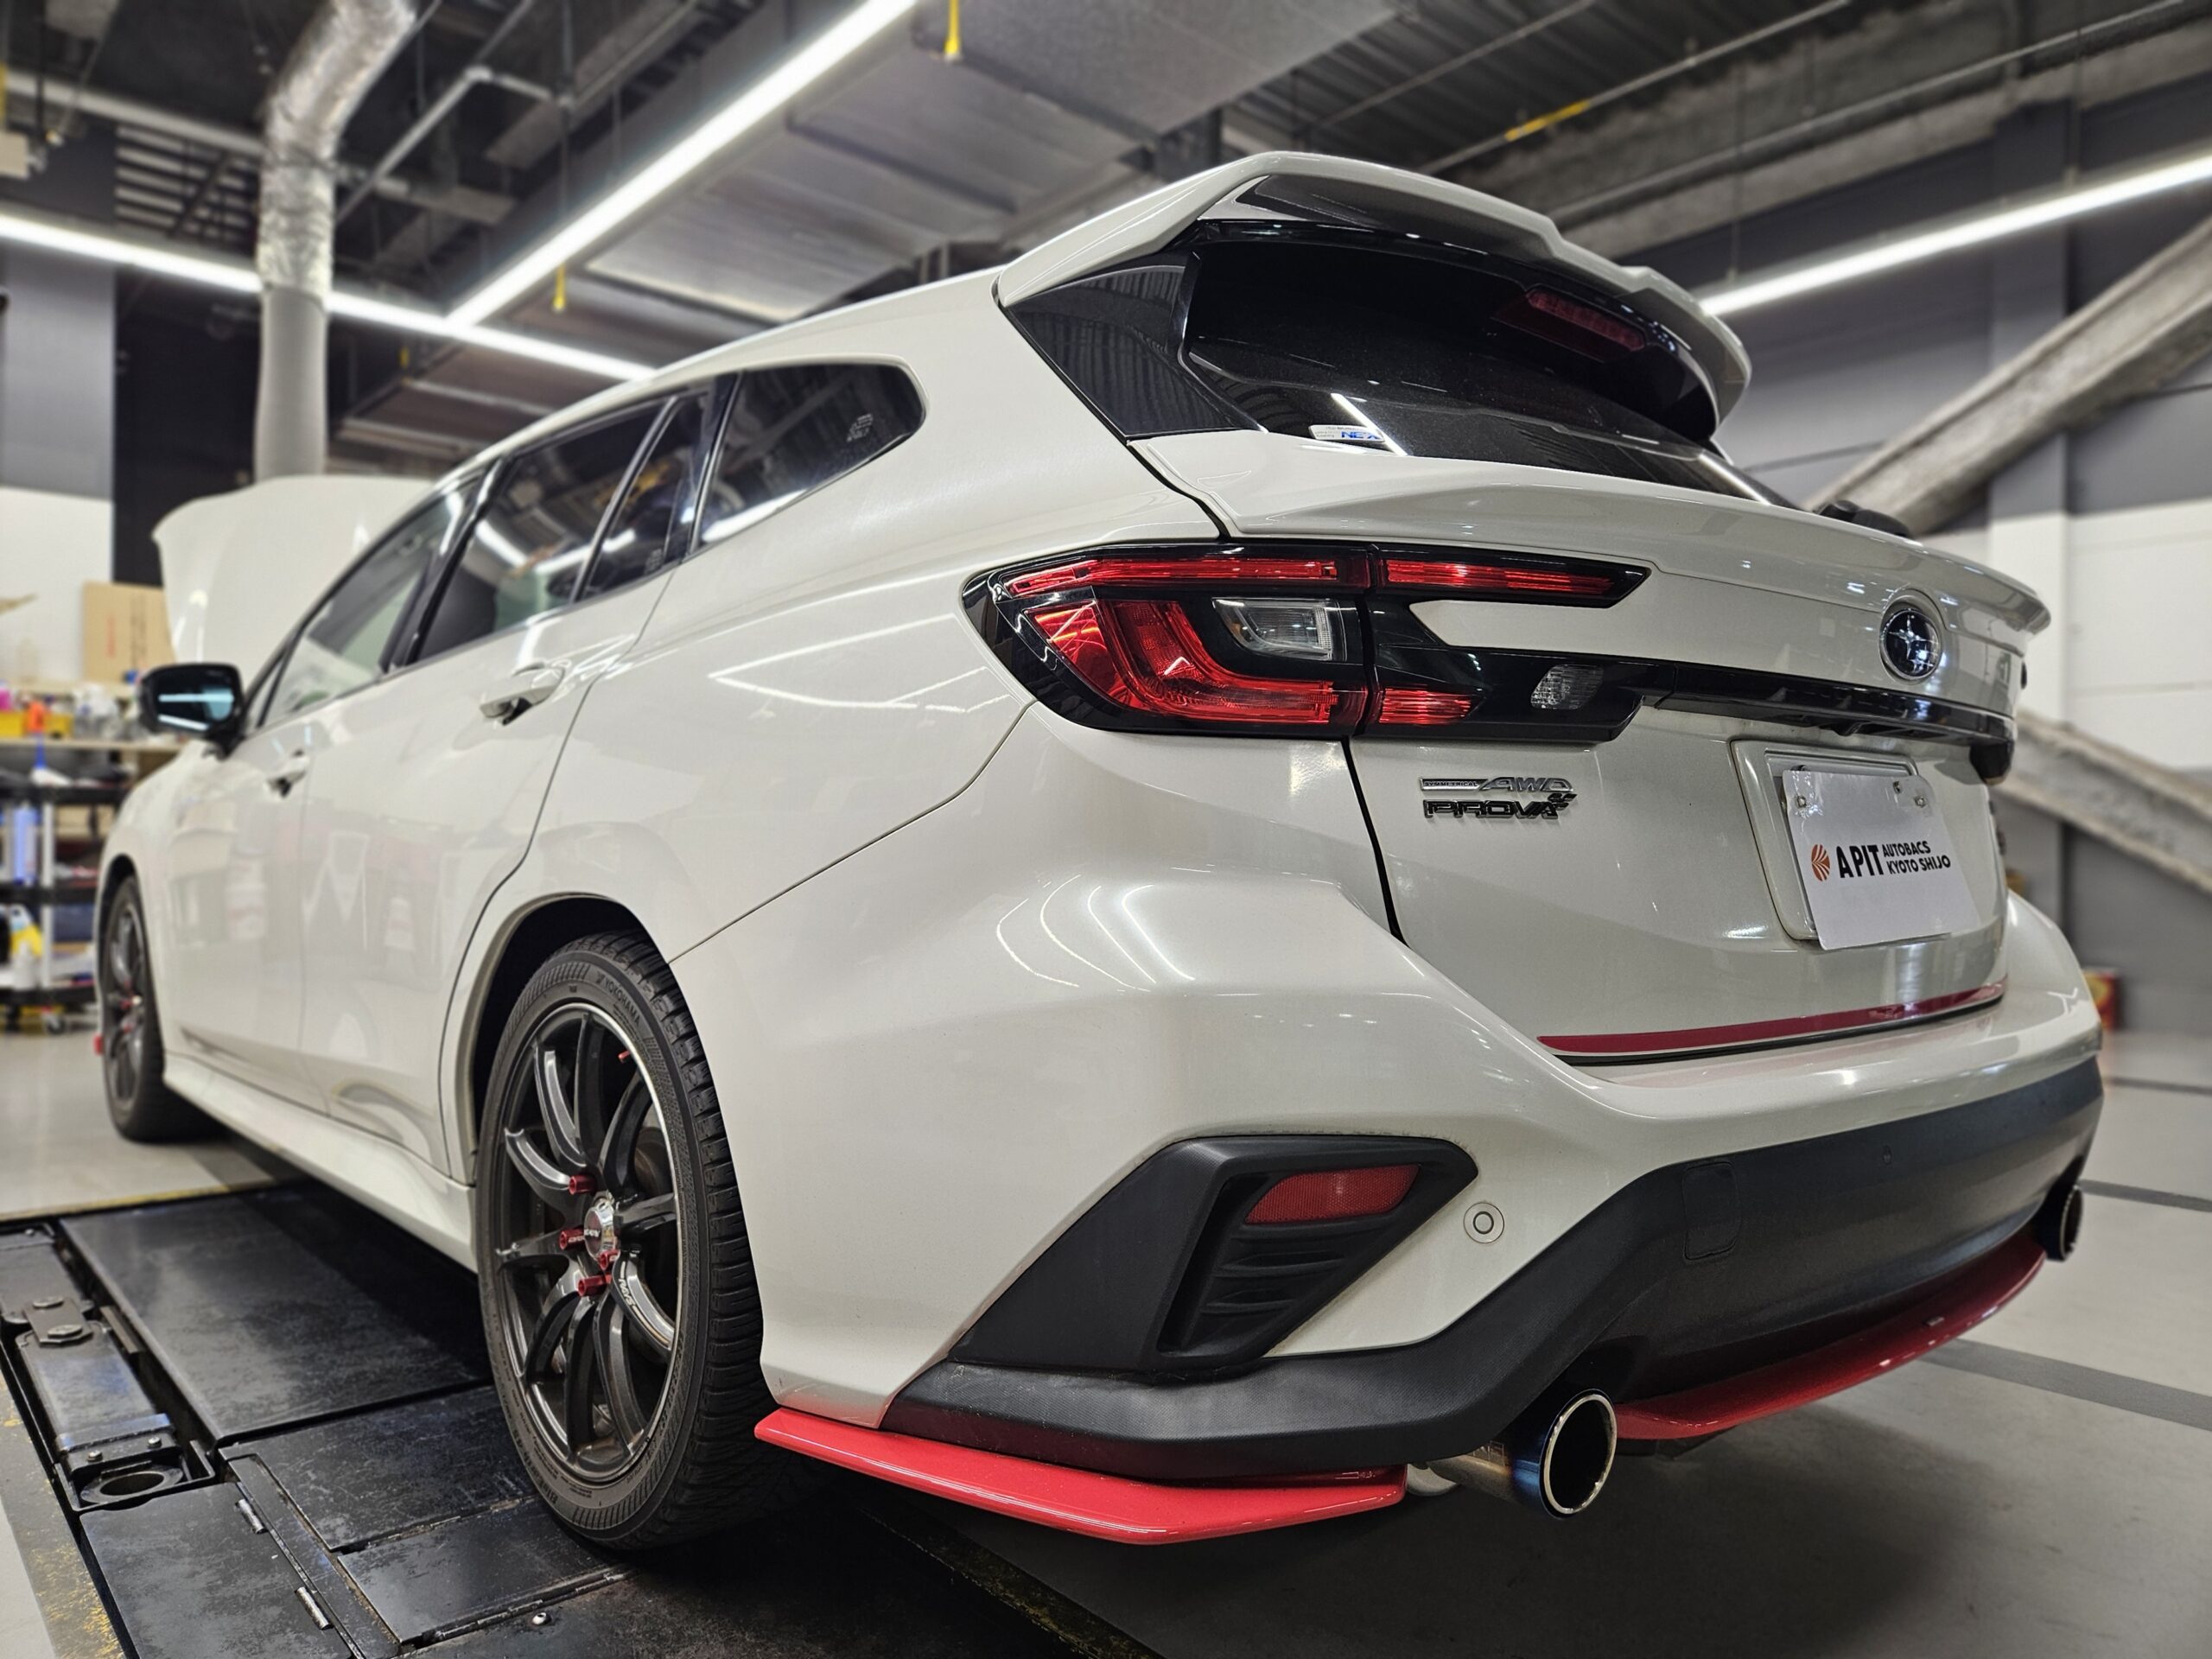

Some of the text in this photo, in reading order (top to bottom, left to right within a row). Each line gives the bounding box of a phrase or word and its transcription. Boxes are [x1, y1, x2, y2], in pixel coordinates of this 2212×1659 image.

[1479, 777, 1573, 792] AWD
[1423, 798, 1559, 820] PROVA
[1882, 841, 1931, 857] AUTOBACS
[1886, 855, 1951, 874] KYOTO SHIJO
[605, 977, 640, 1026] YOKOHAMA
[619, 1278, 635, 1306] RAYS
